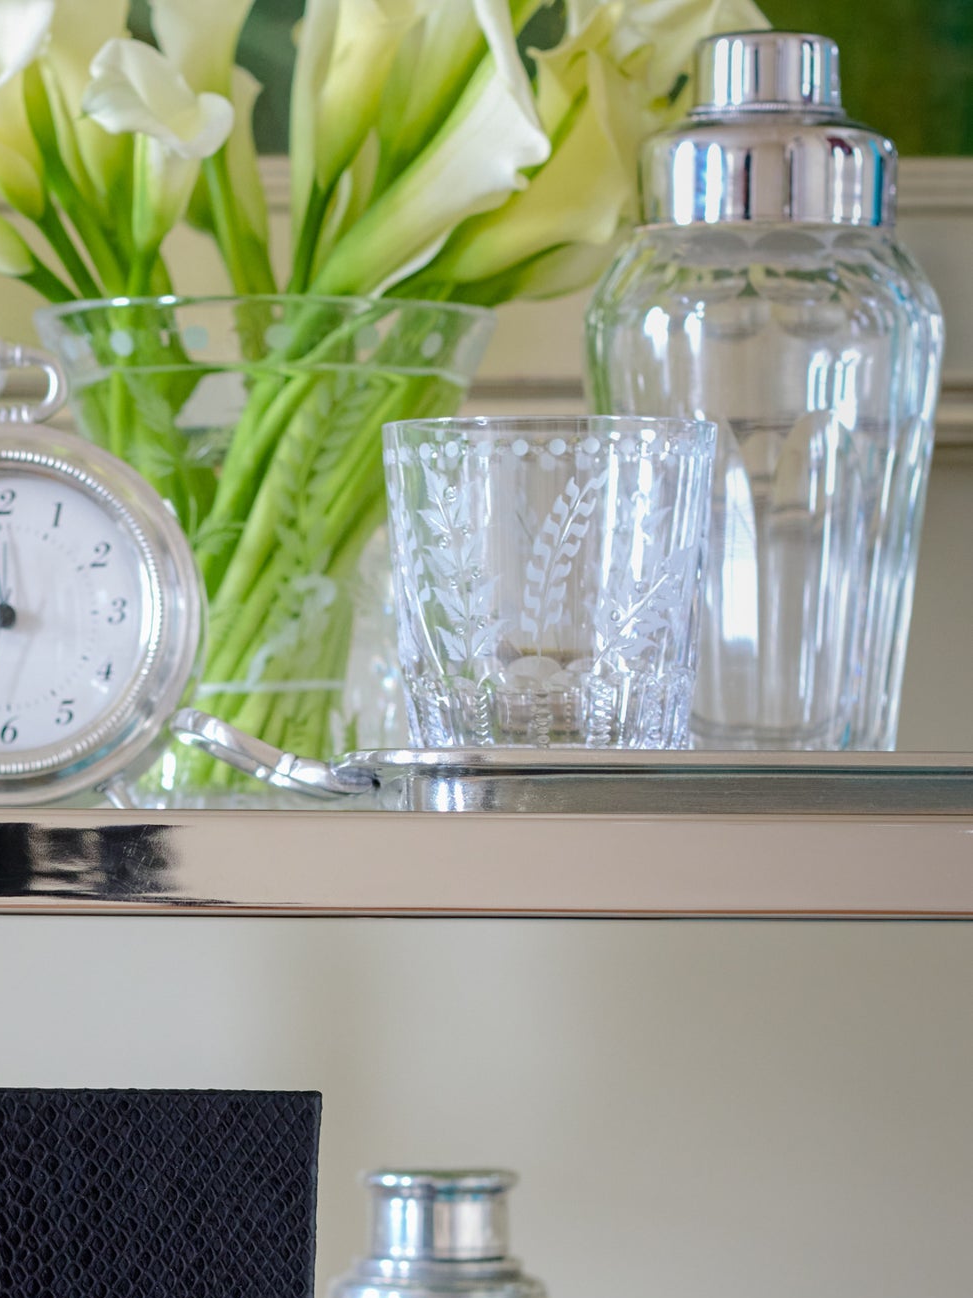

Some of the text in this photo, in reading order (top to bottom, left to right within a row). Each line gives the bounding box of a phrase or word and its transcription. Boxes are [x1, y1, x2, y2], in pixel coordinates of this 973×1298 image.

[51, 502, 63, 528] 1
[90, 542, 112, 569] 2
[107, 600, 128, 625] 3
[96, 661, 114, 682] 4
[55, 699, 76, 725] 5
[0, 715, 19, 744] 6
